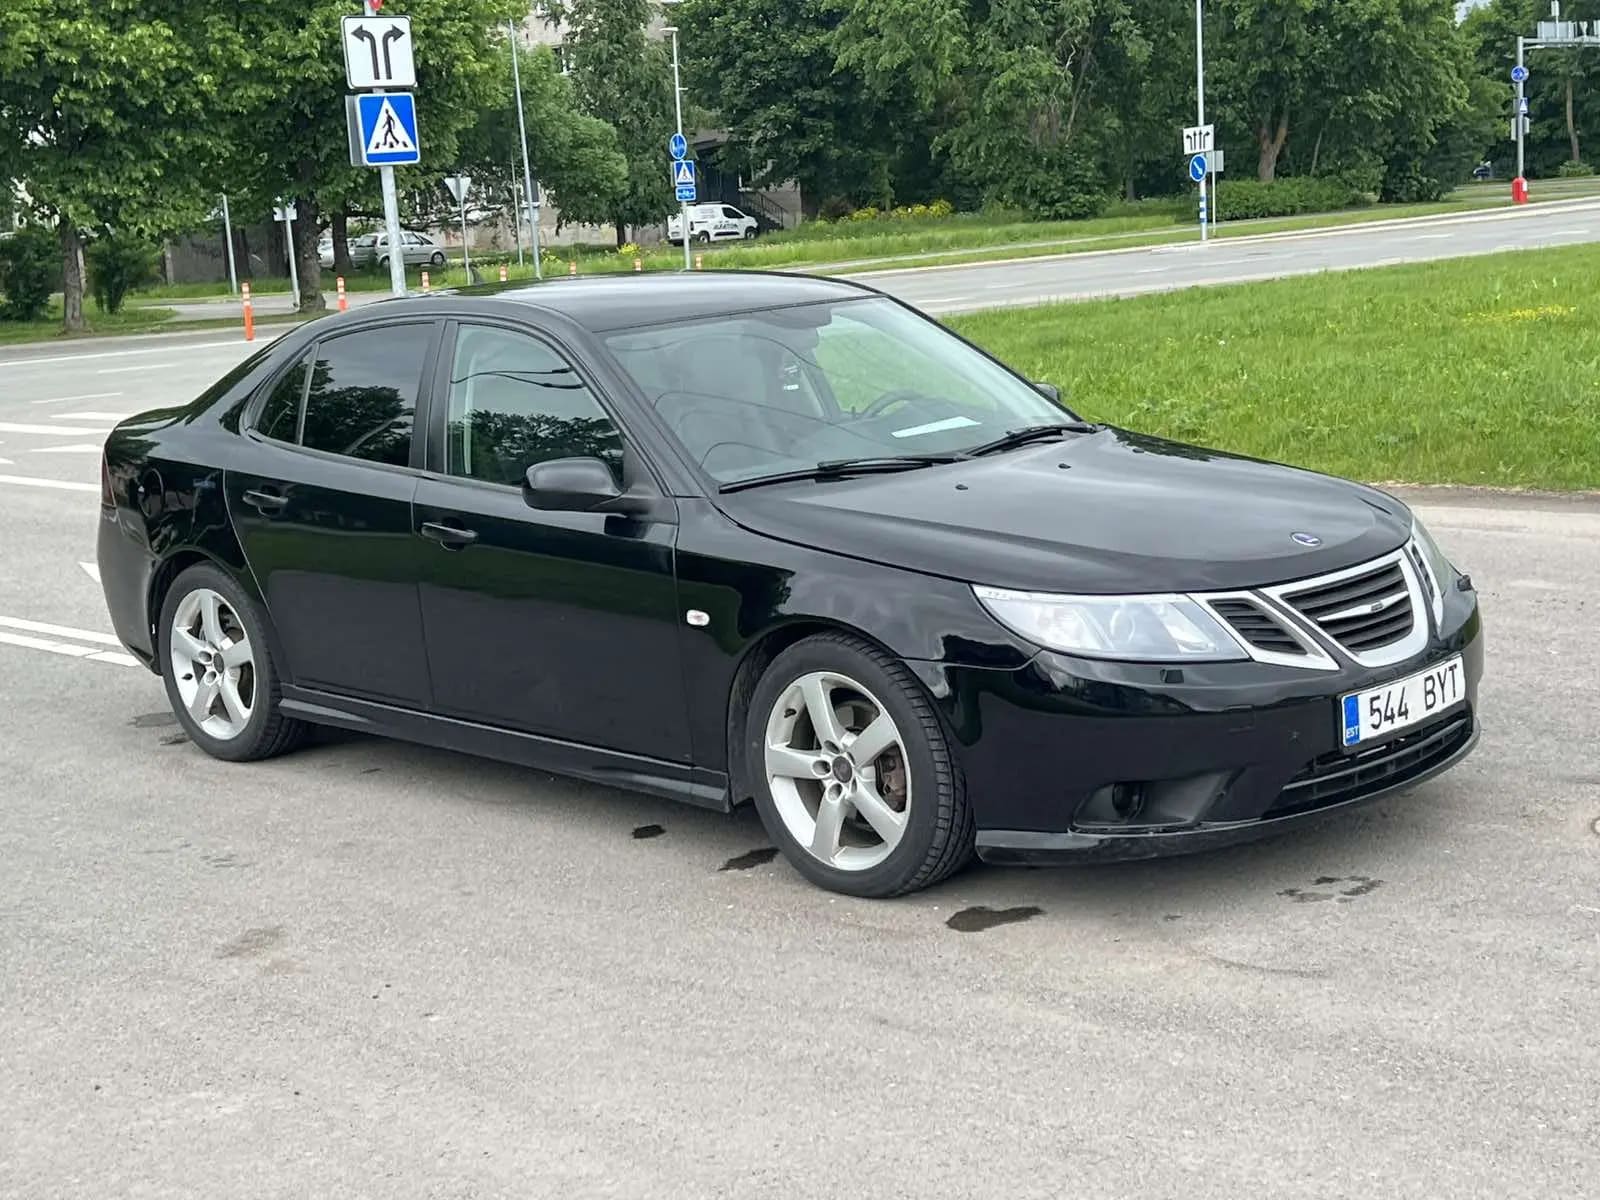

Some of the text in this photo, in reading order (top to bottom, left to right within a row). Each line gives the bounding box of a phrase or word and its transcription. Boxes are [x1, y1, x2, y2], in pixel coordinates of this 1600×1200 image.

[1369, 663, 1458, 730] 544 BYT
[1346, 725, 1359, 738] EST
